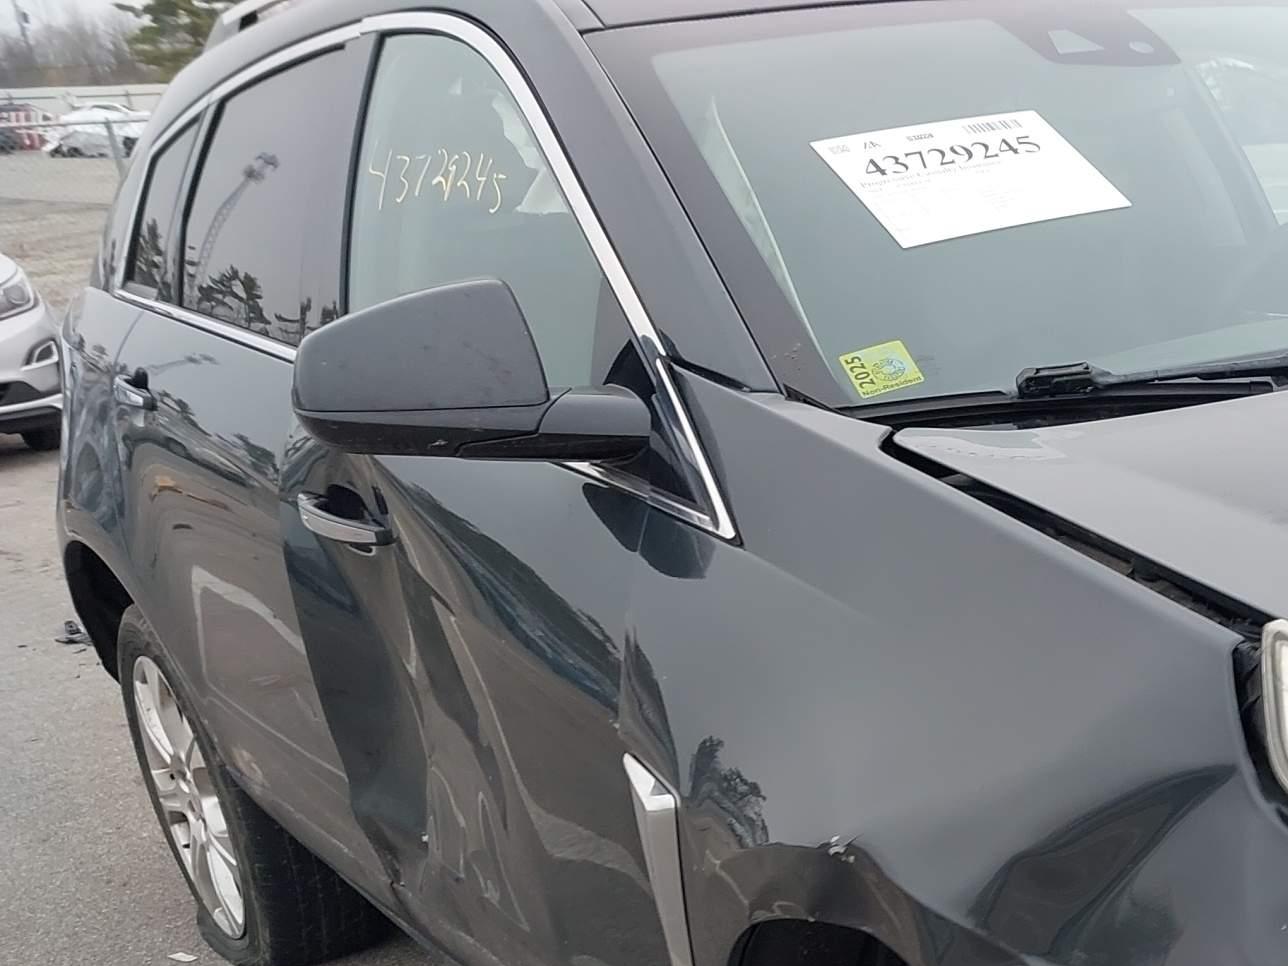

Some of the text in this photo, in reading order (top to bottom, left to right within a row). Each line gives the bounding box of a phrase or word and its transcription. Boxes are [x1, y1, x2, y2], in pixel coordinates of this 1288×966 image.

[865, 135, 1041, 176] 43729245
[369, 139, 507, 214] 43729245
[844, 356, 876, 389] 2025
